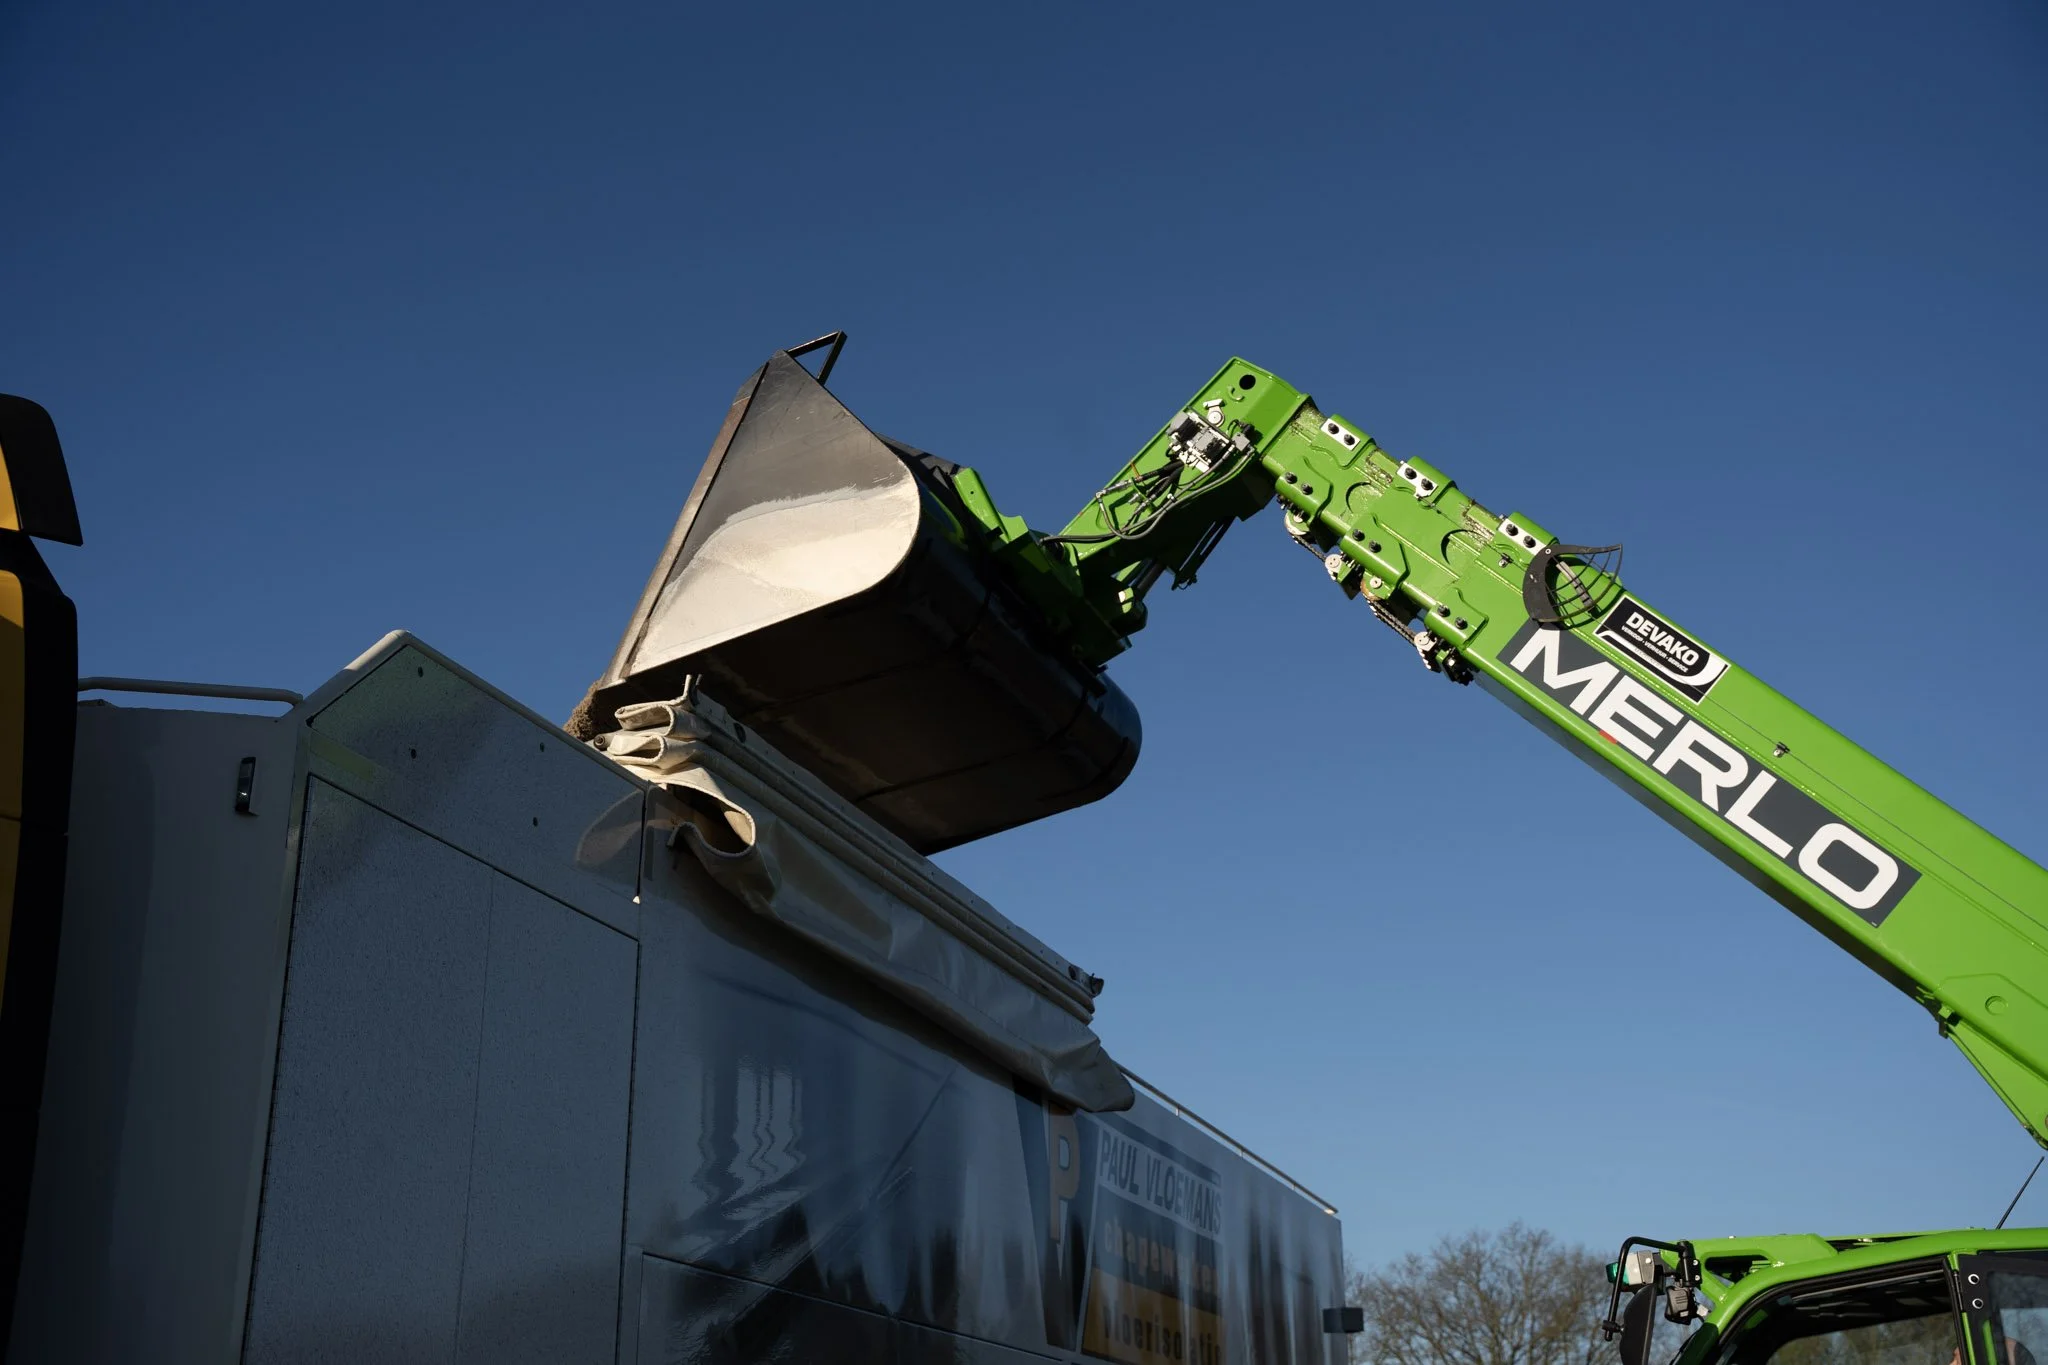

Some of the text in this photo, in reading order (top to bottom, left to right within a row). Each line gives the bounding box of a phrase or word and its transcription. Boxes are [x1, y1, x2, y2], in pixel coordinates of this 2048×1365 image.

[1625, 611, 1700, 666] DEVAKO
[1667, 656, 1689, 673] SERVICE
[1510, 629, 1899, 909] MERLO
[1099, 1128, 1223, 1235] PAUL VLOEMANS
